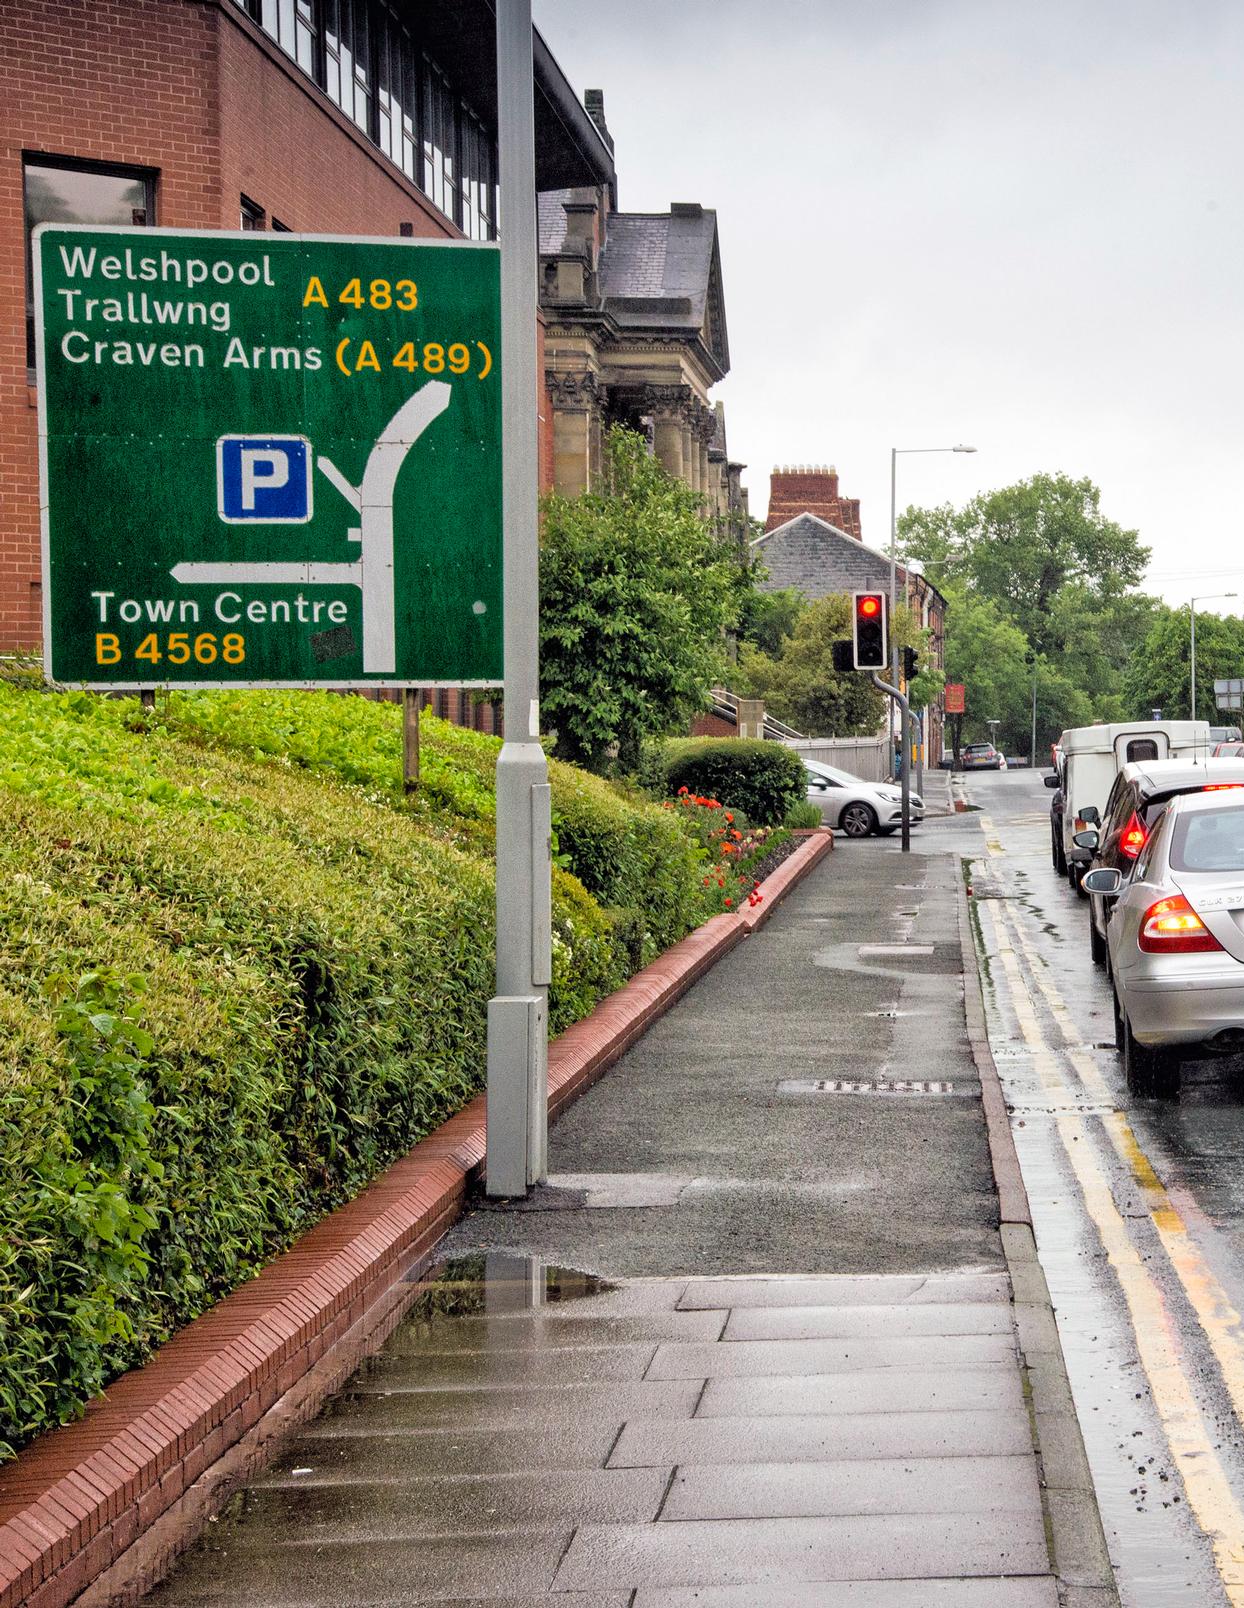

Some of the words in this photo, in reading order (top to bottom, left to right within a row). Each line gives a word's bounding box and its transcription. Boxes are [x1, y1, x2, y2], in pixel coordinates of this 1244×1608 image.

[59, 245, 275, 287] Welshpool
[57, 288, 231, 331] Trallwng
[303, 276, 329, 308] A
[338, 278, 419, 311] 483
[61, 330, 204, 368] Craven
[223, 337, 322, 370] Arms
[335, 337, 381, 376] (A
[392, 342, 493, 379] 489)
[241, 448, 289, 511] P
[91, 592, 199, 623] Town
[214, 593, 348, 624] Centre
[96, 633, 122, 665] B
[135, 633, 246, 665] 4568
